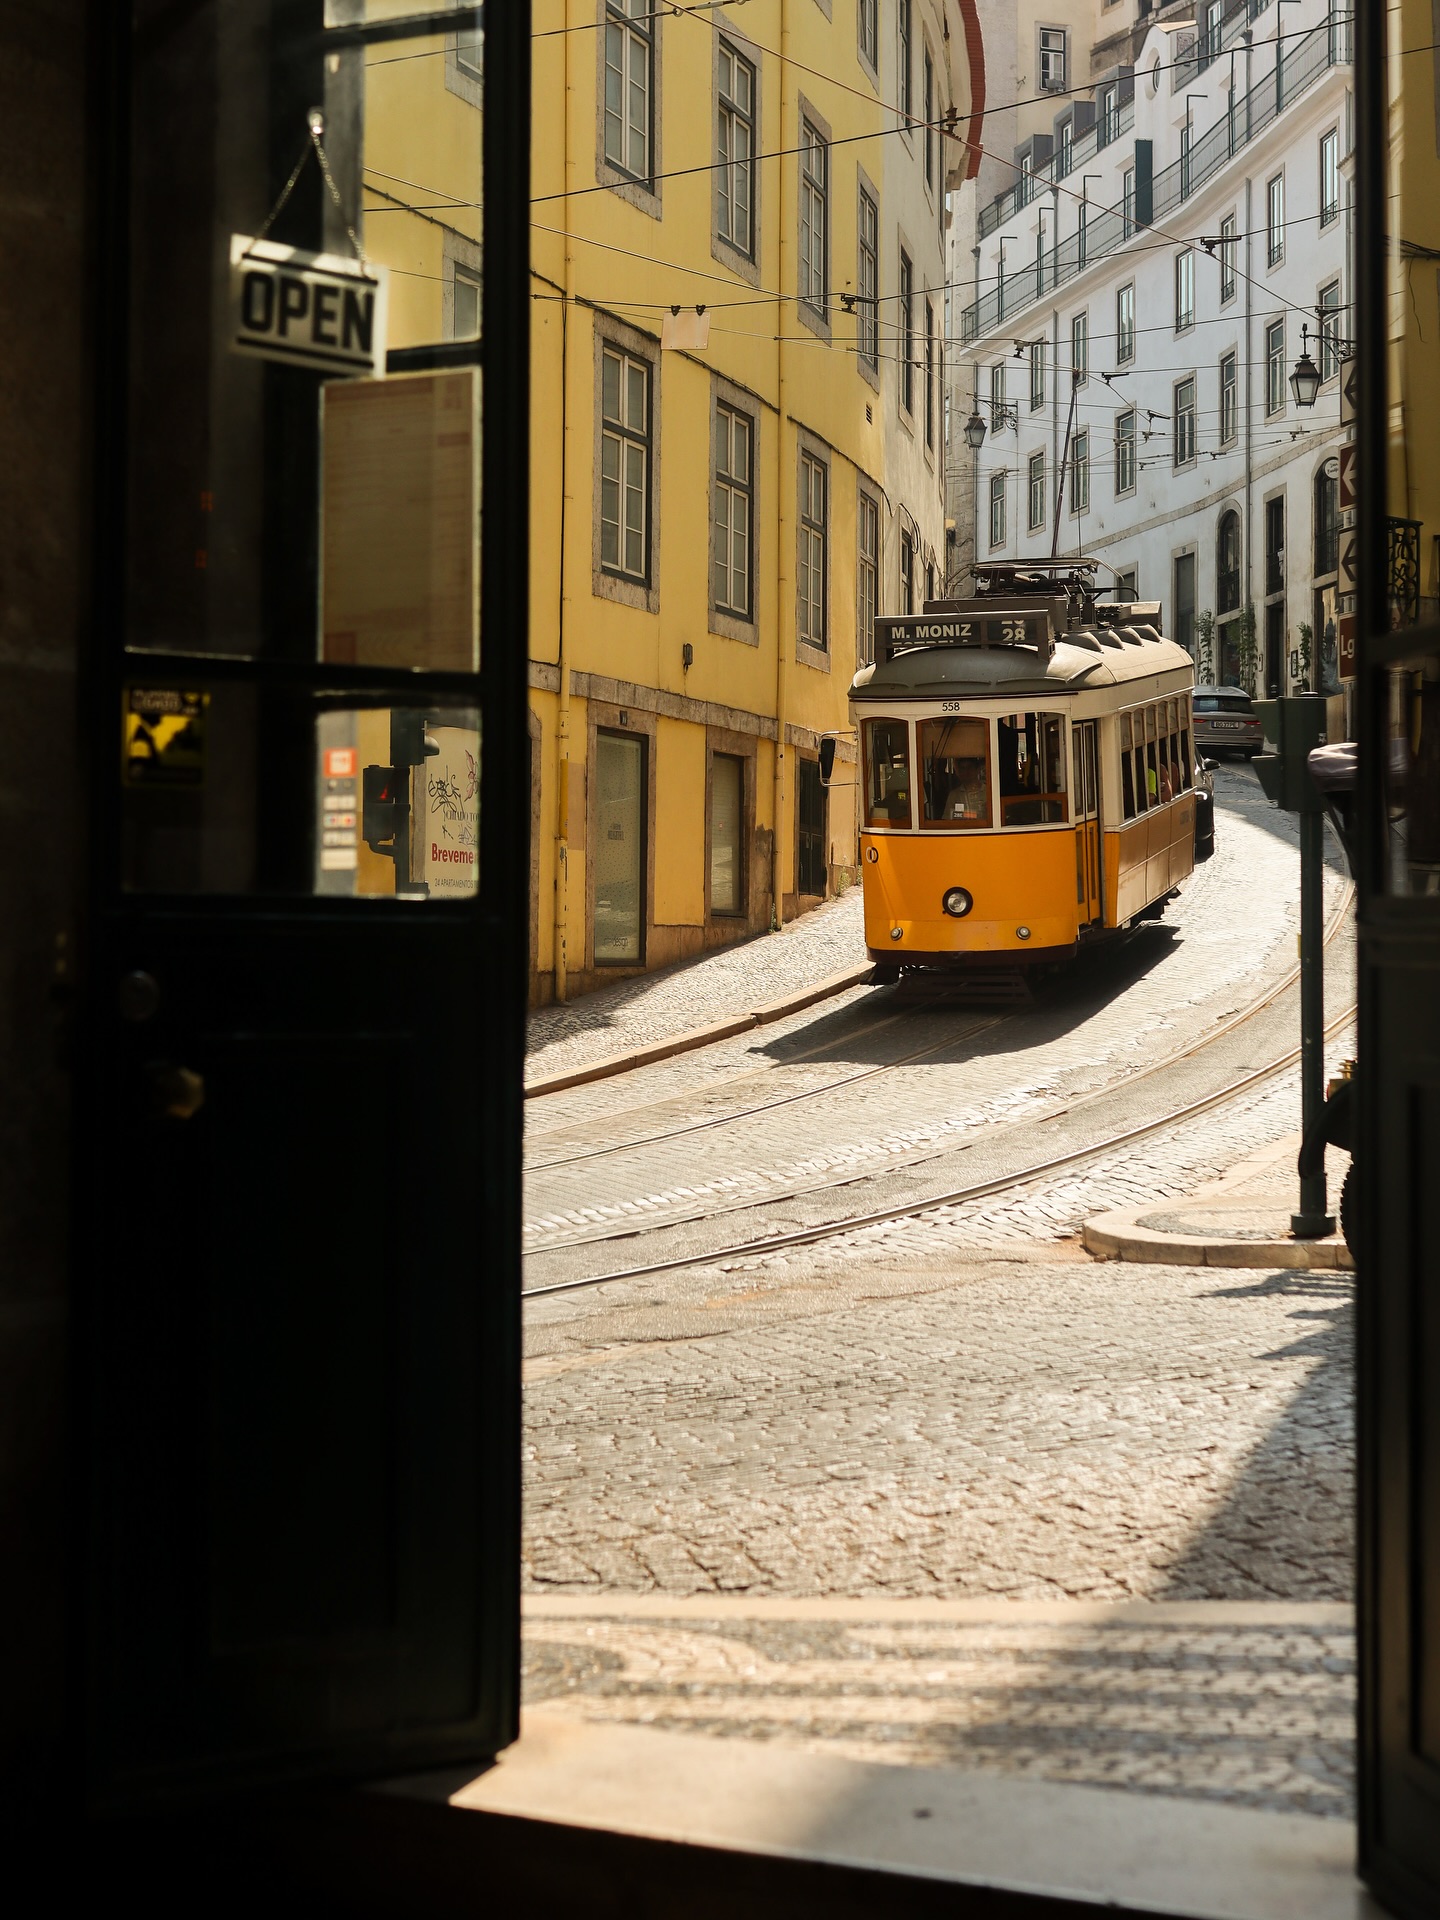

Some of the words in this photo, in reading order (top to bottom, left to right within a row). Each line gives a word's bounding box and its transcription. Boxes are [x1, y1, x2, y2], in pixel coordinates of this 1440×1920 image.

[241, 271, 374, 353] OPEN
[891, 626, 911, 639] M.
[915, 623, 972, 638] MONIZ
[1002, 627, 1026, 641] 28
[942, 702, 960, 712] 558
